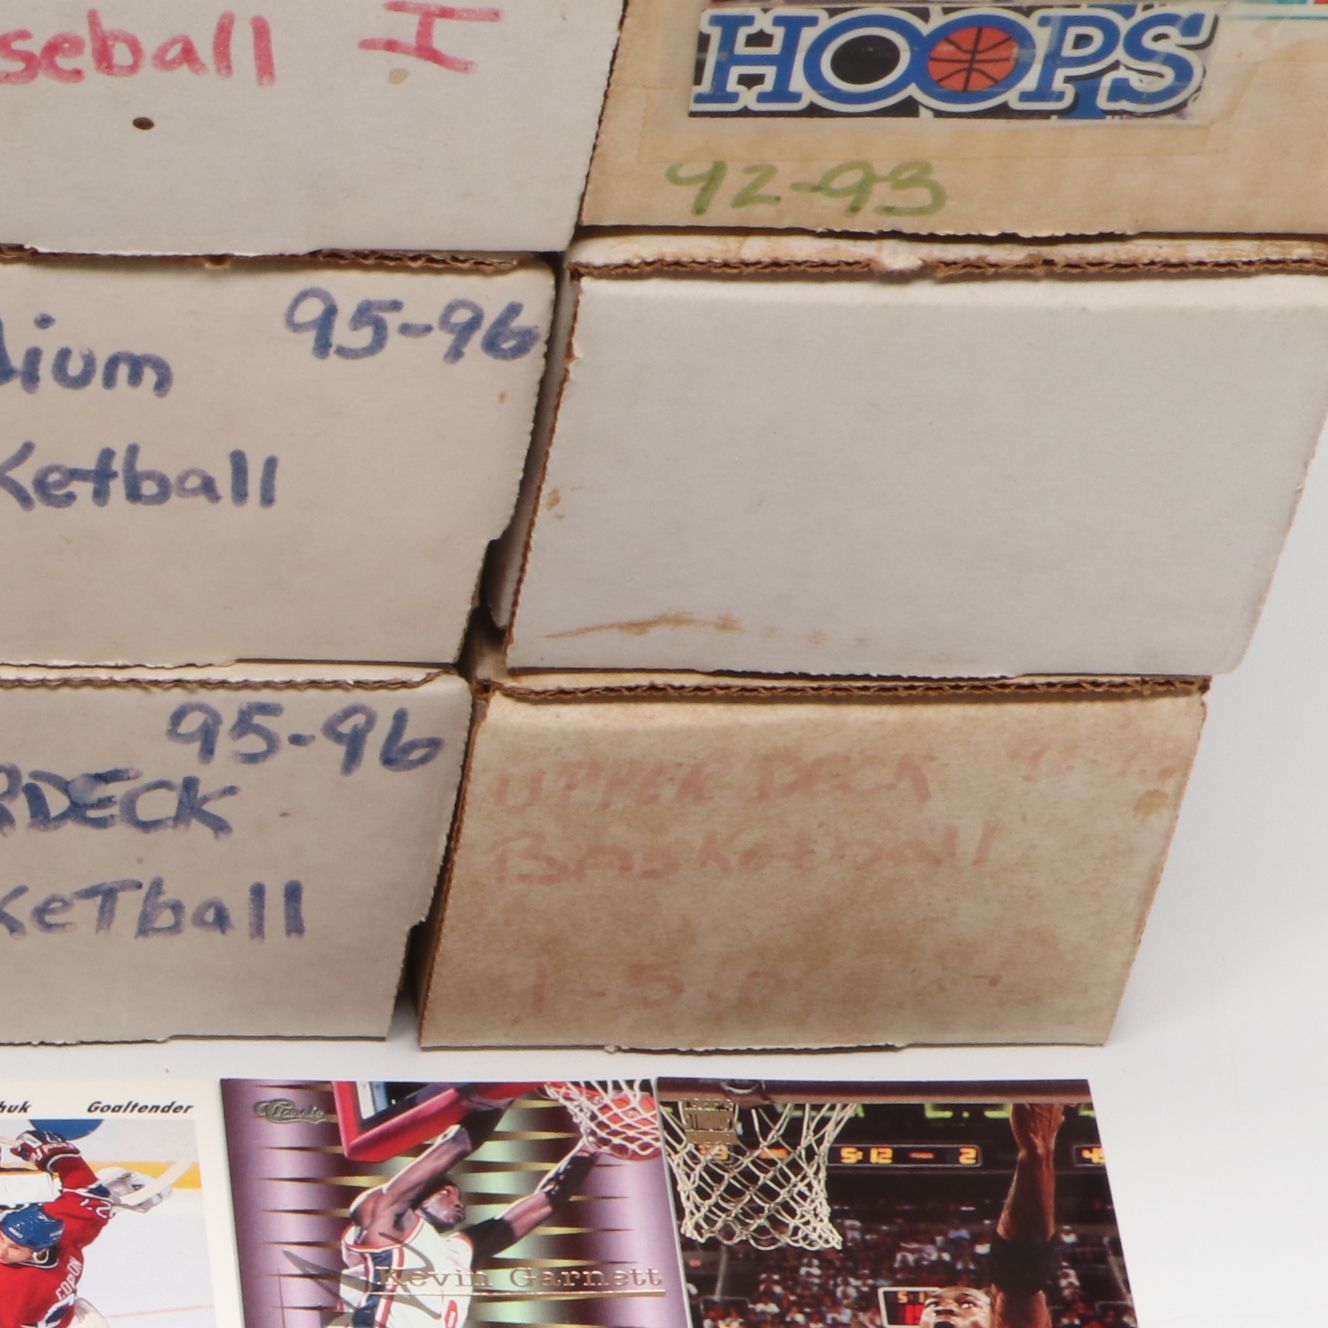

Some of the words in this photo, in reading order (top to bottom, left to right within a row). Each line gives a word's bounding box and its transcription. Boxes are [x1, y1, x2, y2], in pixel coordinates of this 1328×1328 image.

[692, 5, 1219, 114] HOOPS
[284, 286, 541, 364] 95-96
[166, 702, 443, 777] 95-96
[86, 1100, 194, 1115] Goaltender
[374, 1265, 494, 1288] Kevin
[508, 1265, 664, 1288] Garnett
